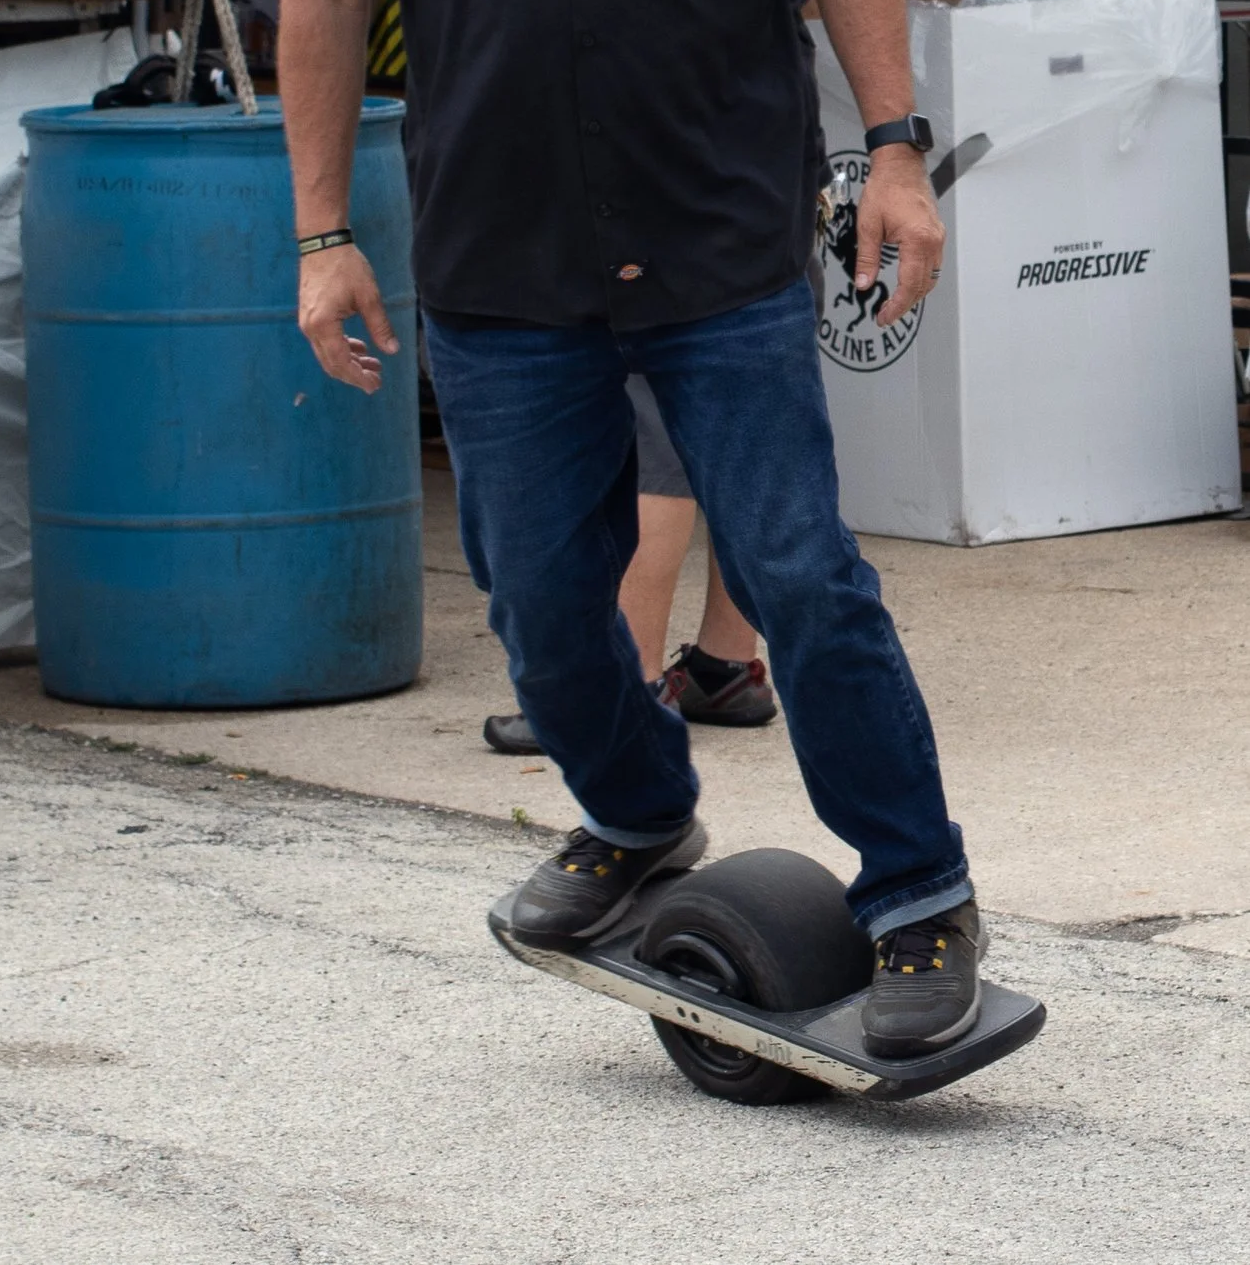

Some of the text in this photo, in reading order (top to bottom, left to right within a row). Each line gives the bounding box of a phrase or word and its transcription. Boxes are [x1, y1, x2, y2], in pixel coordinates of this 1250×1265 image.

[1053, 240, 1104, 254] POWERED BY
[1016, 249, 1151, 289] PROGRESSIVE
[820, 318, 878, 363] OLINE
